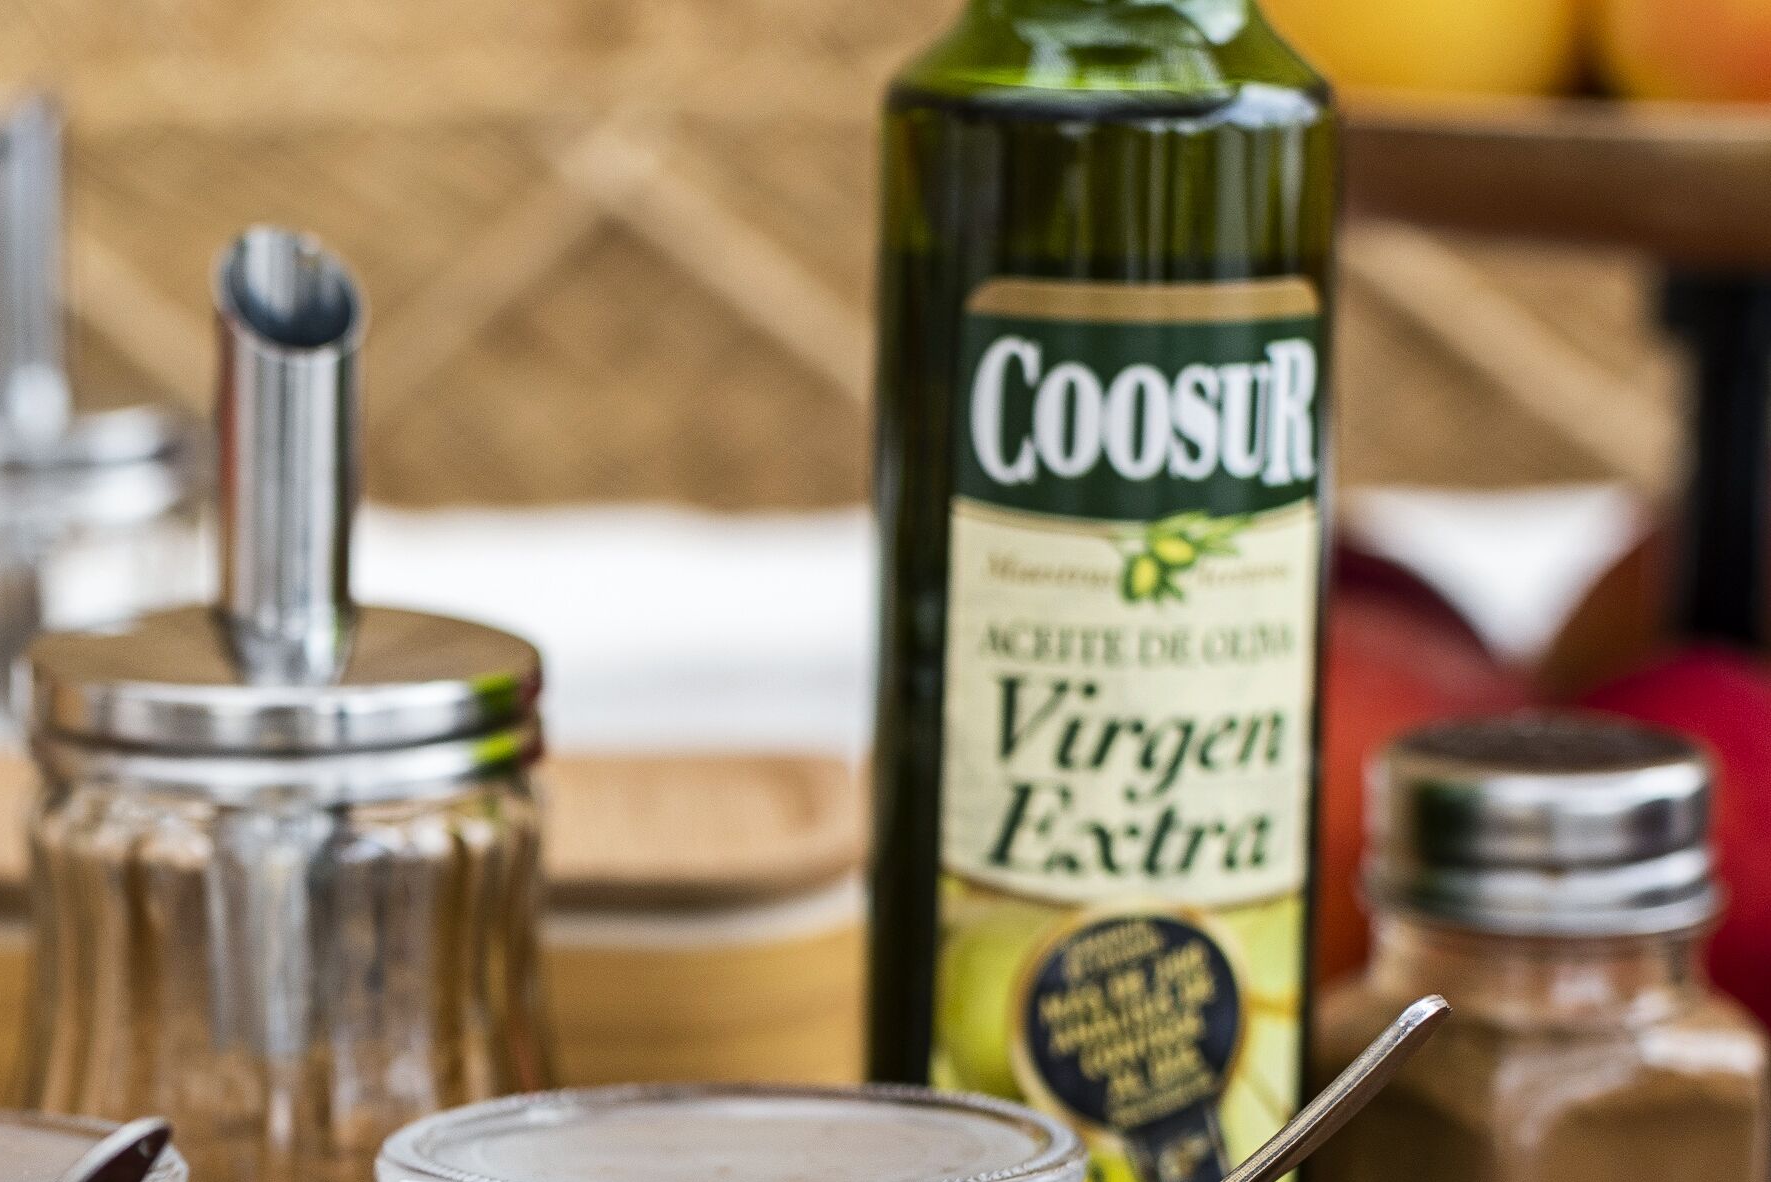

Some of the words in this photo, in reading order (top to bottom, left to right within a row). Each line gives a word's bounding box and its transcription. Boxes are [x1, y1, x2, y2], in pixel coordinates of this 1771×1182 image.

[969, 335, 1317, 487] COOSUR
[980, 620, 1125, 667] ACEITE
[1137, 624, 1191, 667] DE
[994, 676, 1286, 803] Virgen
[988, 783, 1272, 876] Extra
